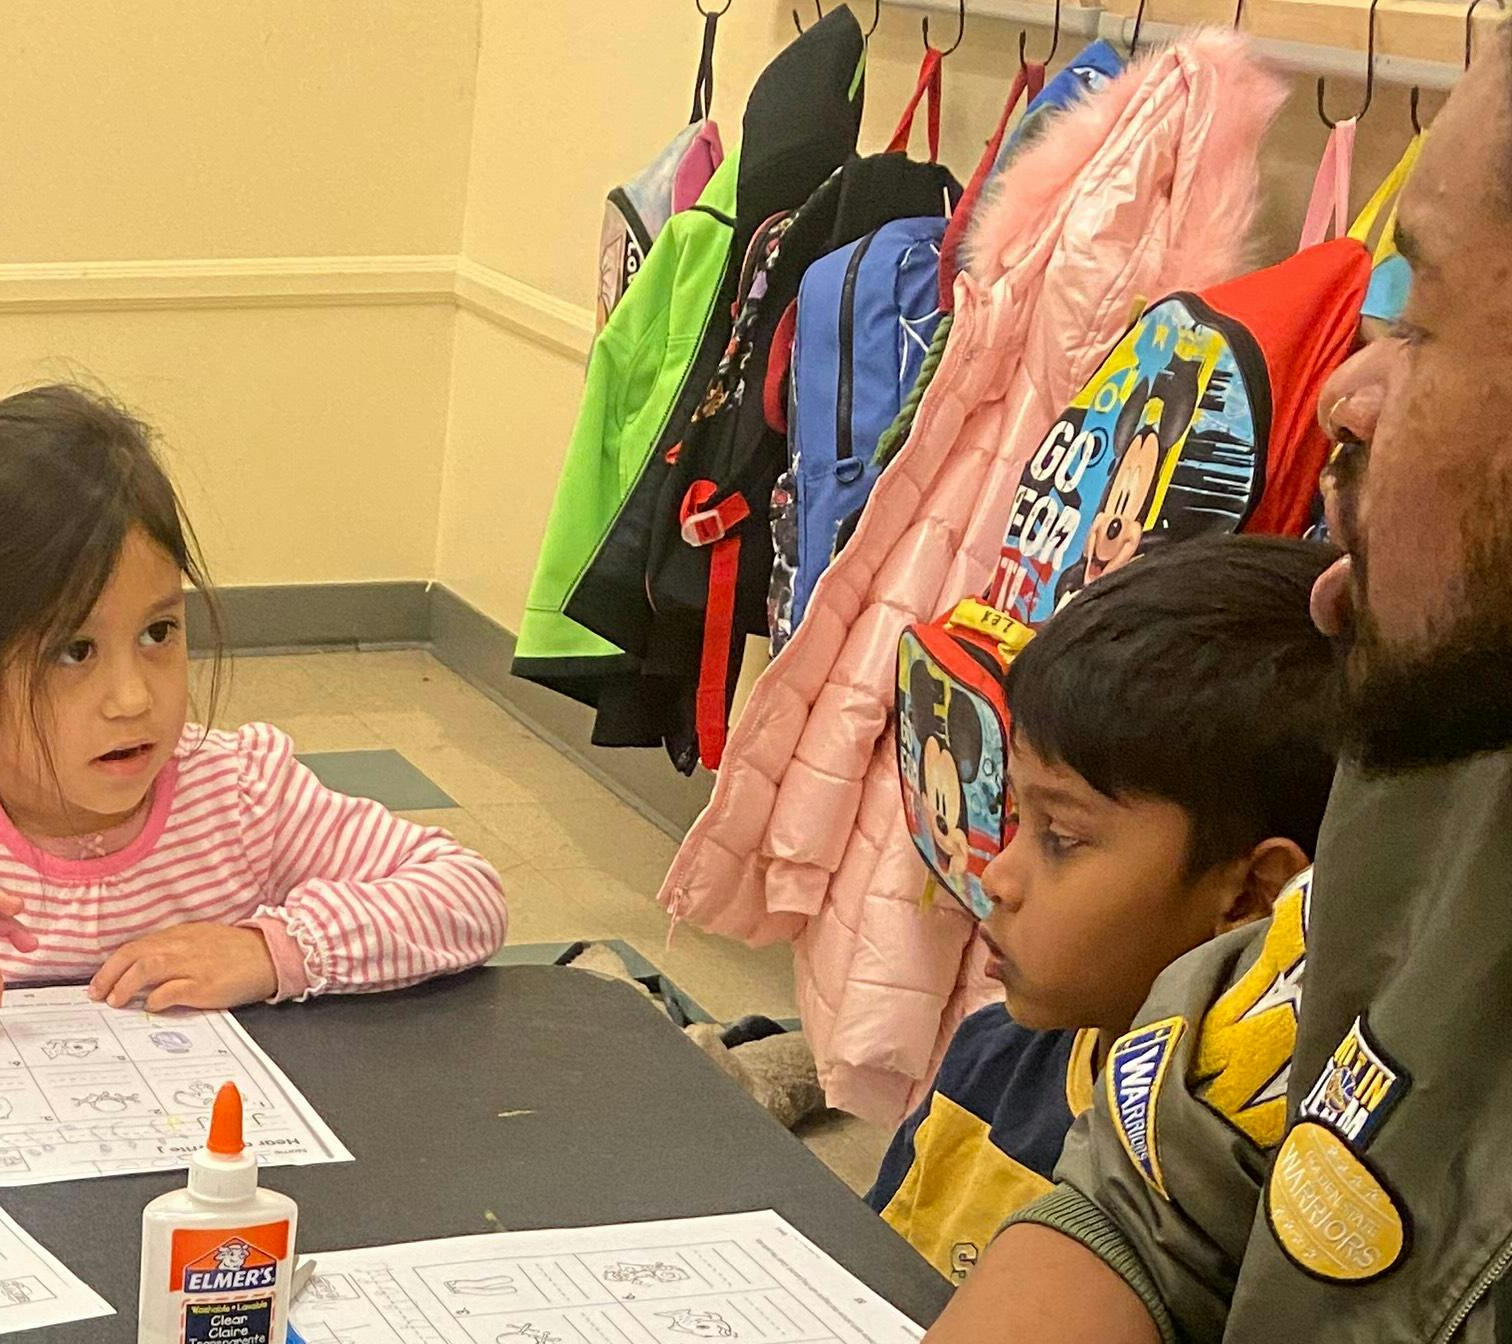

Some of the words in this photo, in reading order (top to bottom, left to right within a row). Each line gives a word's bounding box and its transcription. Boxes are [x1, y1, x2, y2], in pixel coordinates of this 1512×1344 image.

[1030, 420, 1095, 493] GO
[1003, 484, 1081, 571] FOR
[1120, 1045, 1160, 1161] WARRIORS
[1281, 1142, 1382, 1268] WARRIORS
[189, 1267, 273, 1290] ELMER'S
[208, 1326, 249, 1339] Claire
[211, 1315, 248, 1327] Clear
